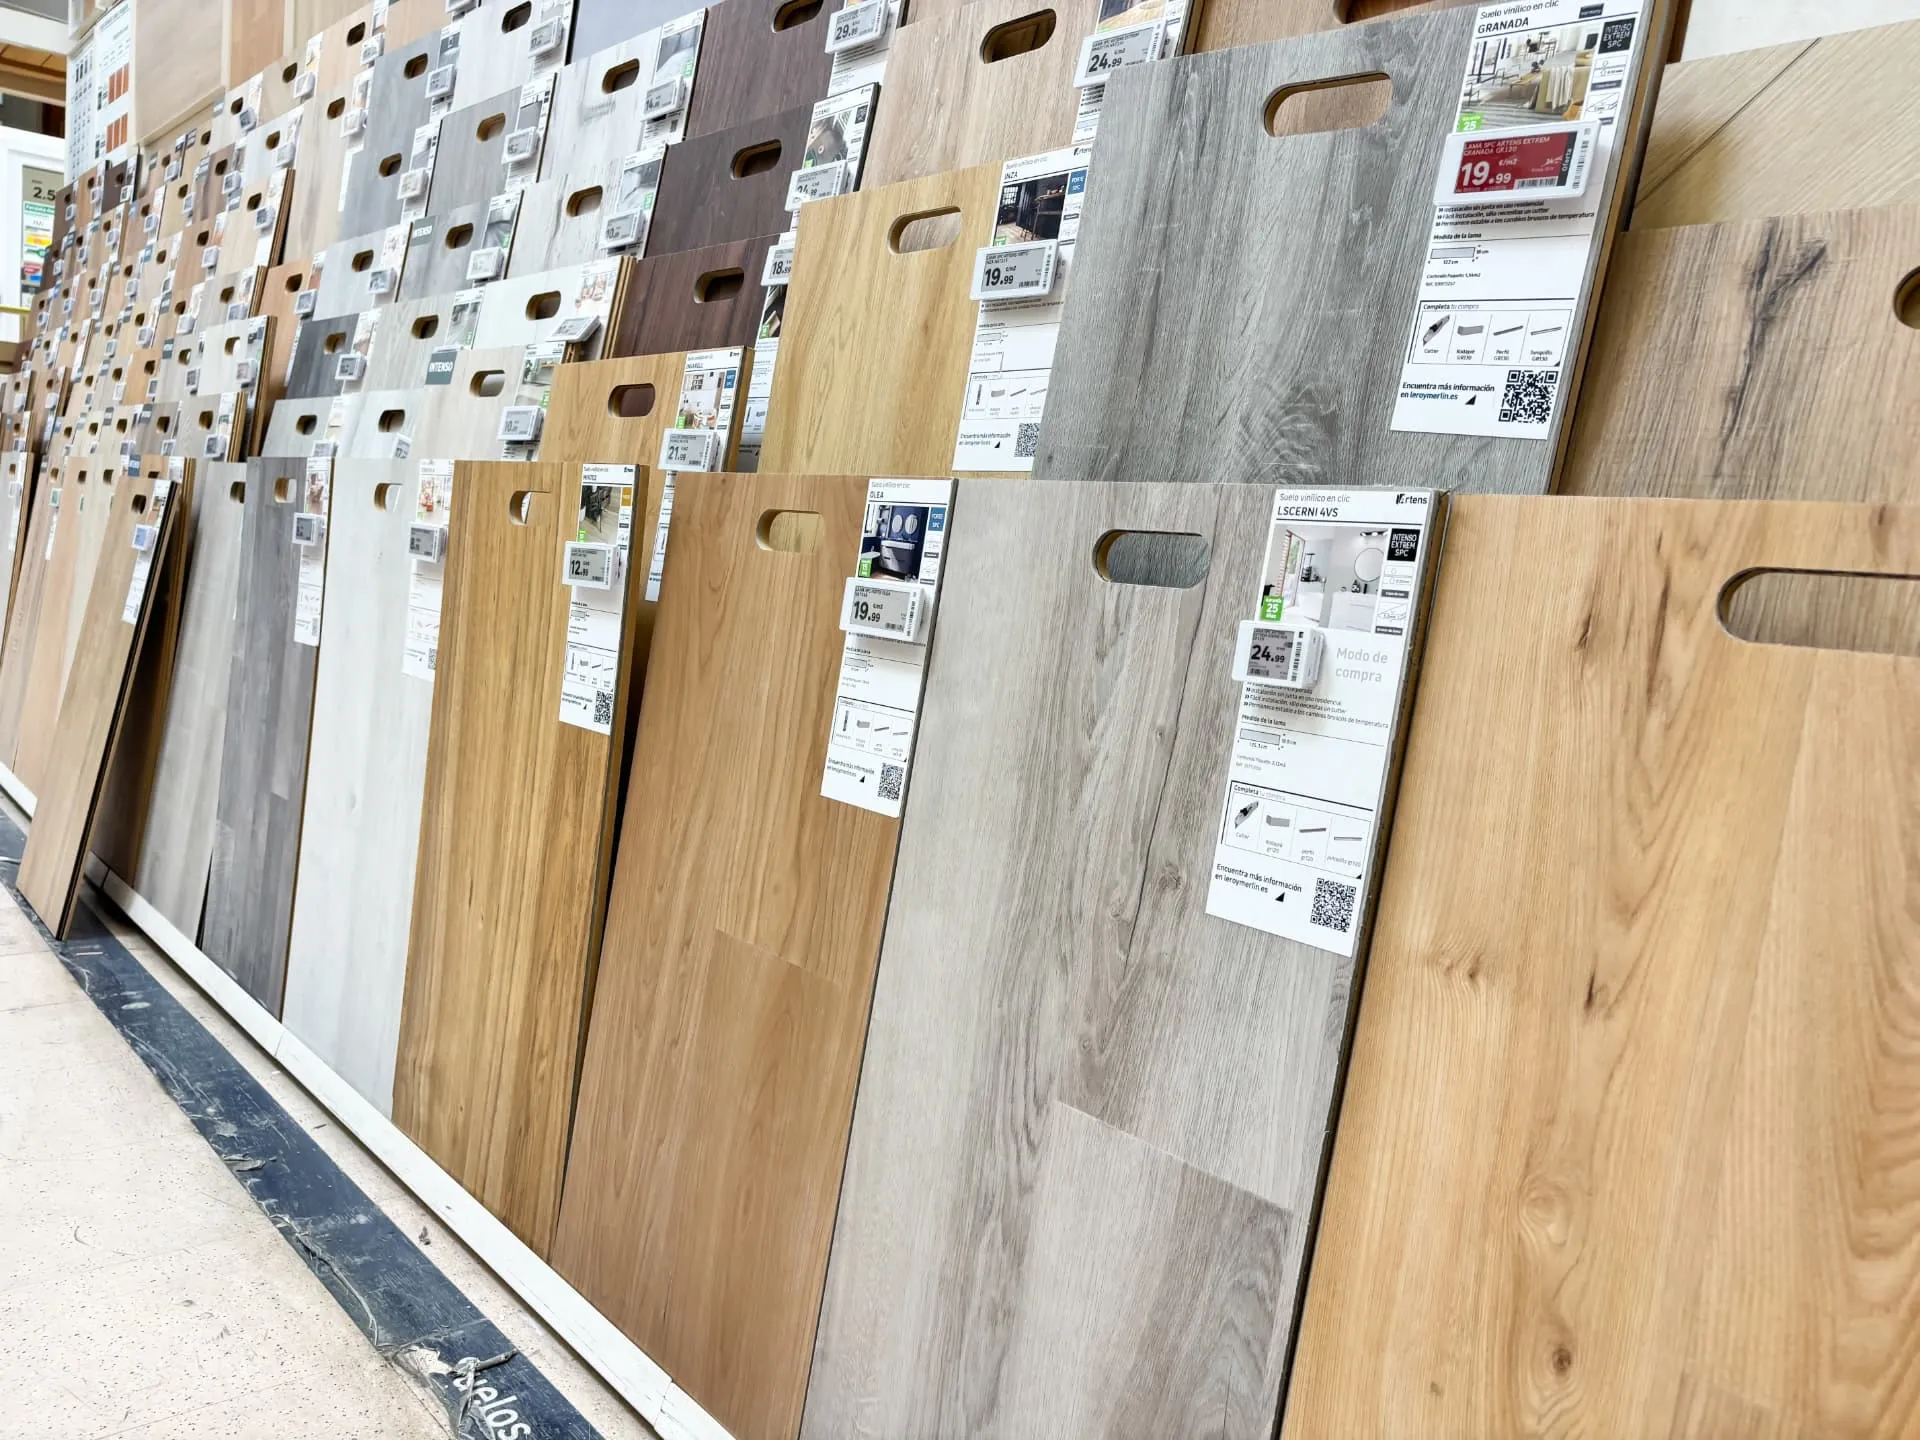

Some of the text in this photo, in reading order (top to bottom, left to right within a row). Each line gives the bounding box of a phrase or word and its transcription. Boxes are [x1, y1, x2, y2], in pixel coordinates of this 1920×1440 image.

[1480, 9, 1501, 20] Suelo
[1503, 4, 1531, 16] vinílico
[1478, 17, 1529, 34] GRANADA
[1605, 23, 1632, 33] INTENSO
[1603, 31, 1631, 42] EXTREM
[1607, 40, 1622, 49] SPC
[1088, 52, 1122, 72] 24.99
[1463, 121, 1476, 131] 25
[1561, 147, 1573, 172] Oferta
[1004, 171, 1018, 180] INZA
[1461, 161, 1512, 187] 19.99
[985, 267, 1014, 287] 19.99
[1402, 381, 1495, 392] Encuentra más información
[1409, 391, 1458, 400] leroymerlin.es
[1279, 493, 1351, 503] Suelo vinílico en clic
[1277, 506, 1339, 518] LSCERNI 4VS
[1391, 533, 1417, 542] INTENSO
[1391, 540, 1416, 550] EXTREM
[1394, 549, 1409, 557] SPC
[854, 600, 881, 623] 19.99
[1266, 603, 1279, 613] 25
[1250, 644, 1286, 663] 24.99
[1336, 647, 1389, 664] Modo de
[1335, 666, 1382, 683] compra
[1233, 784, 1259, 796] Completa
[1214, 873, 1223, 881] en
[1216, 863, 1302, 892] Encuentra más información
